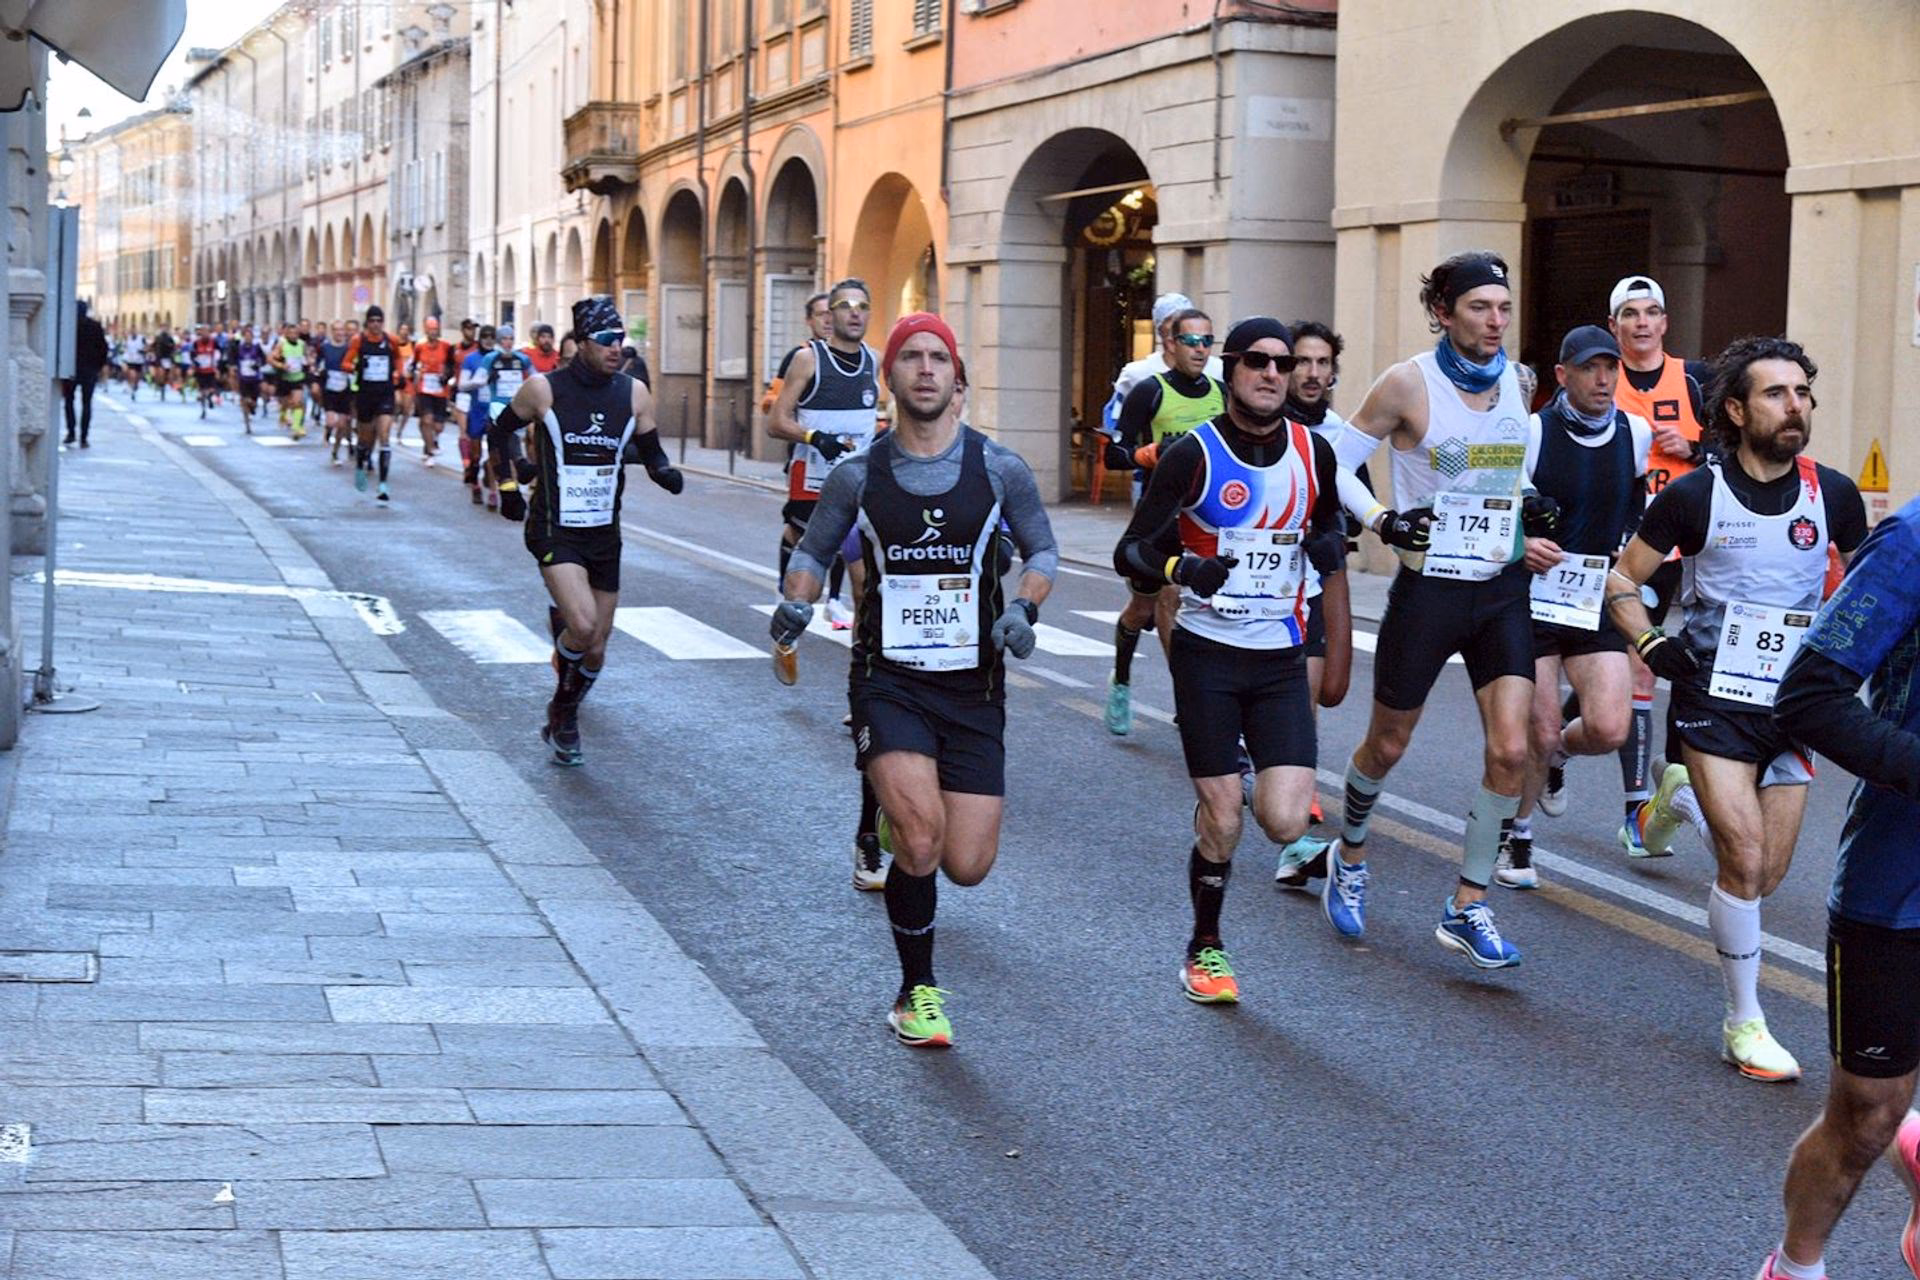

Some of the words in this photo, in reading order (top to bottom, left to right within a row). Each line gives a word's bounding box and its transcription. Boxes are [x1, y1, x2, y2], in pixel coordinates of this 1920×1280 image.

[1459, 514, 1490, 534] 174
[887, 544, 972, 565] Grottini
[1246, 552, 1281, 571] 179
[1560, 570, 1586, 587] 171
[924, 595, 941, 605] 29
[901, 606, 961, 625] PERNA
[1756, 631, 1785, 653] 83
